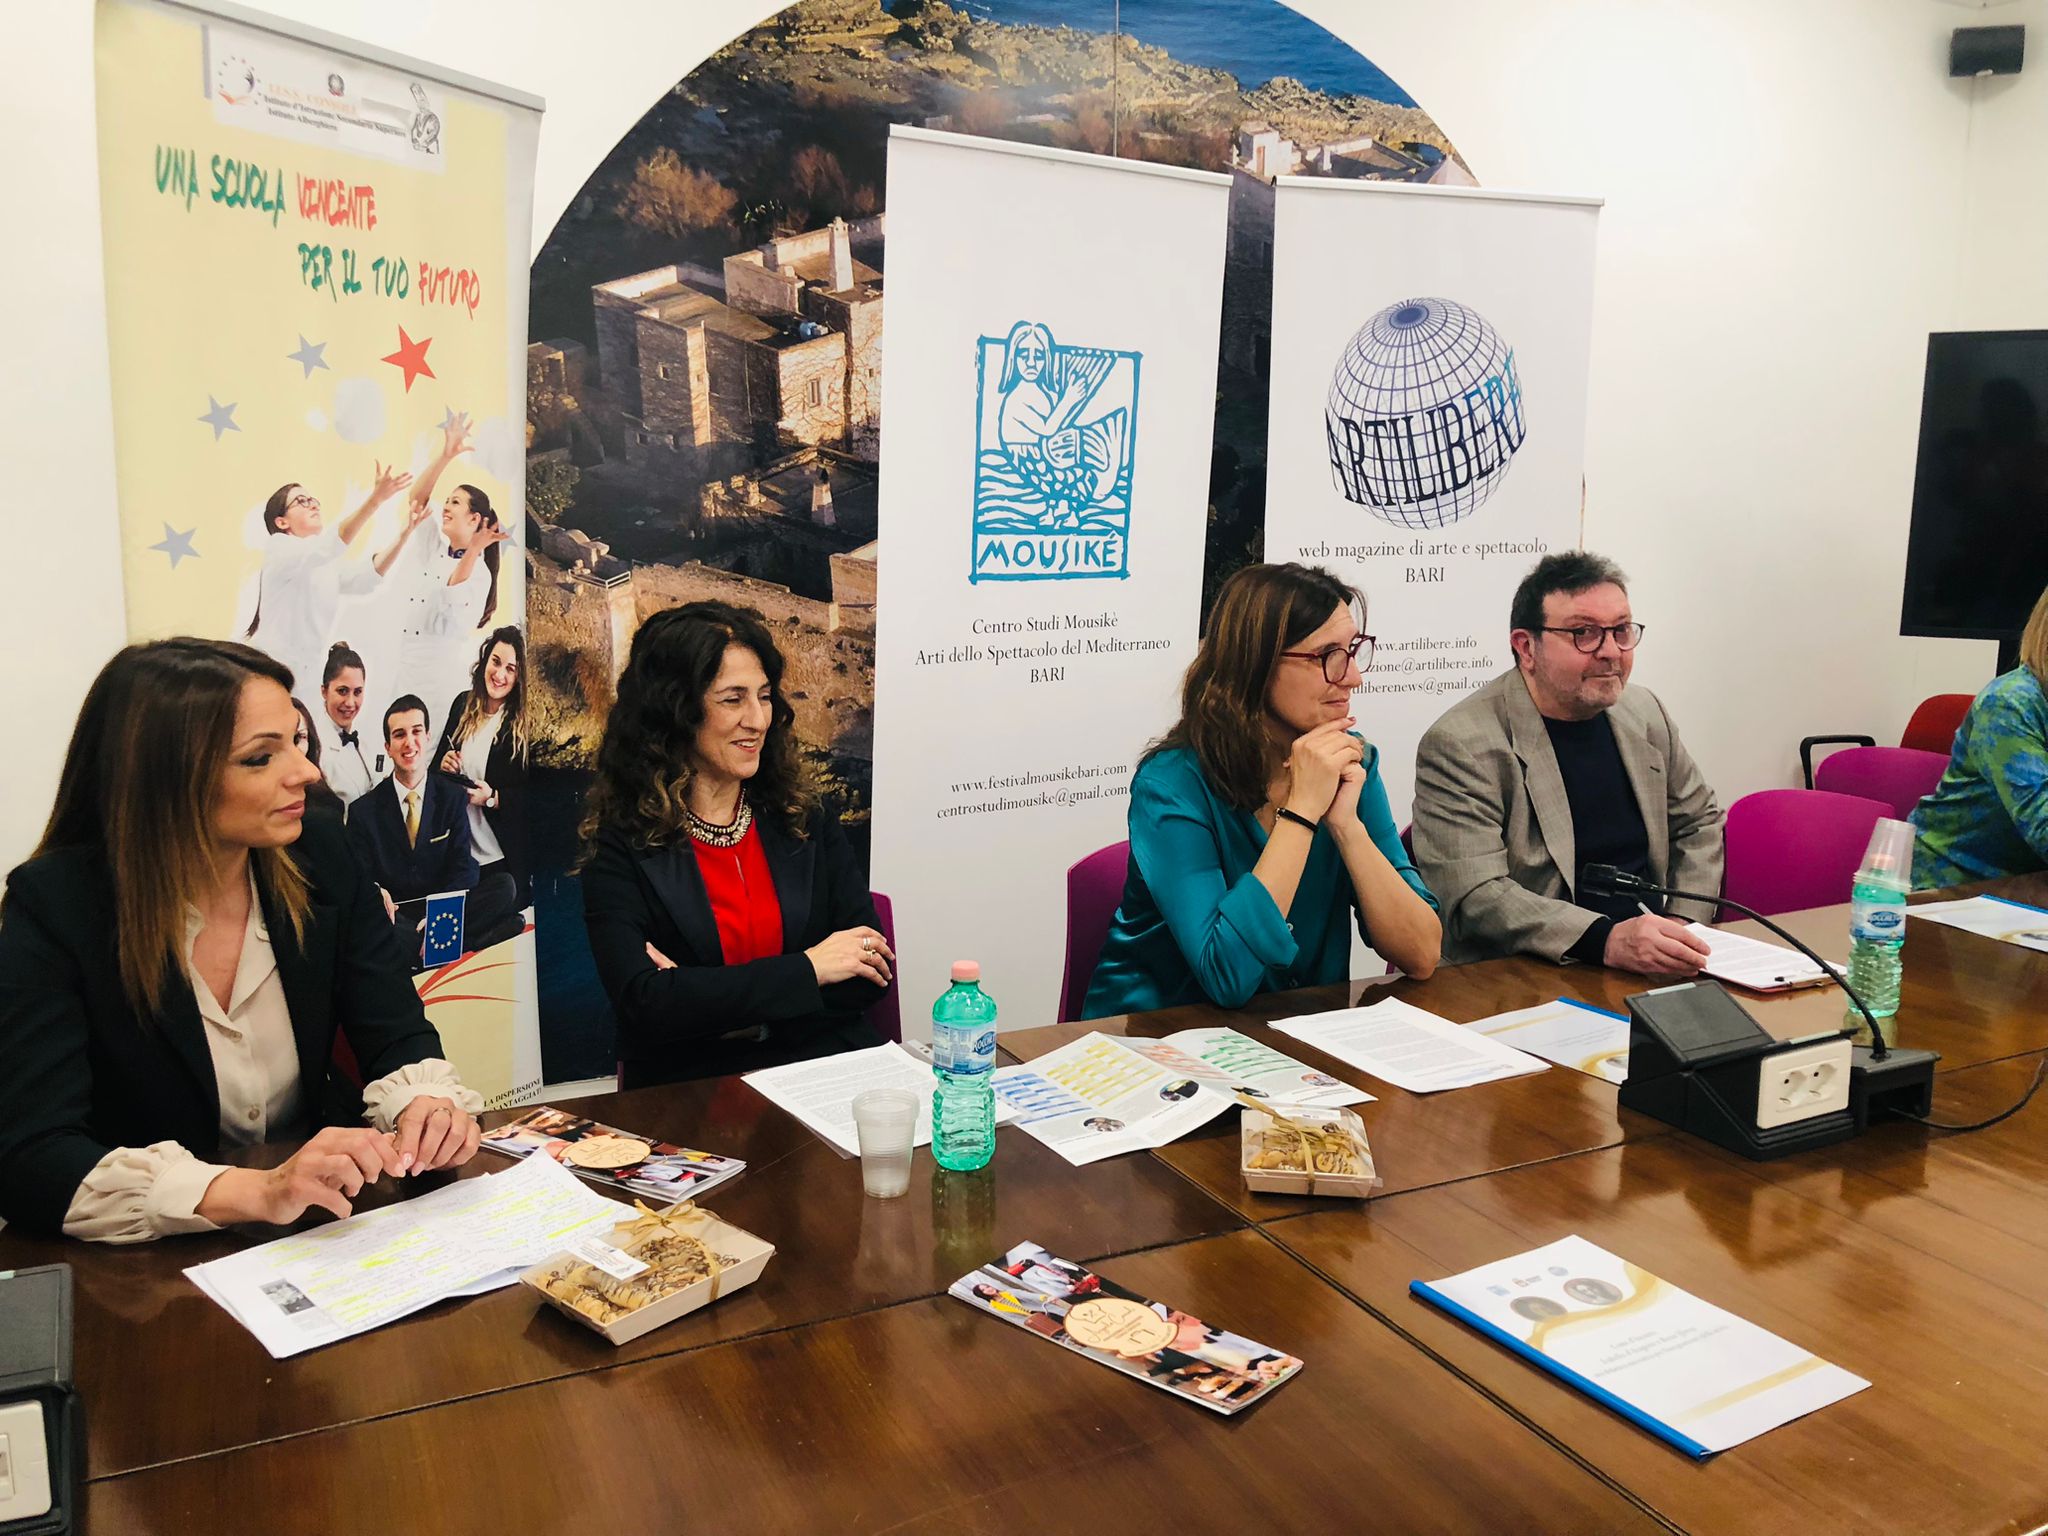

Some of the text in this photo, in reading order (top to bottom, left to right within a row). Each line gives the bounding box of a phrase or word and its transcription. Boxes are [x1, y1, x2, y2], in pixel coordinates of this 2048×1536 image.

[155, 143, 378, 231] UNA SCUOLA VINCENTE
[298, 242, 481, 321] PER IL TUO FUTURO
[978, 531, 1119, 572] MOUSIKÉ
[1299, 537, 1548, 564] web magazine di arte e spettacolo
[1405, 567, 1445, 583] BARI
[972, 611, 1118, 635] Centro Studi Mousikè
[915, 637, 1171, 666] Arti dello Spettacolo del Mediterraneo
[1374, 634, 1478, 652] ww.artilibere.info
[1030, 667, 1065, 684] BARI
[1370, 655, 1493, 675] zione@artilibere.info
[951, 764, 1128, 793] www.festivalmousikebari.com
[937, 785, 1128, 819] centrostudimousike@gmail.com
